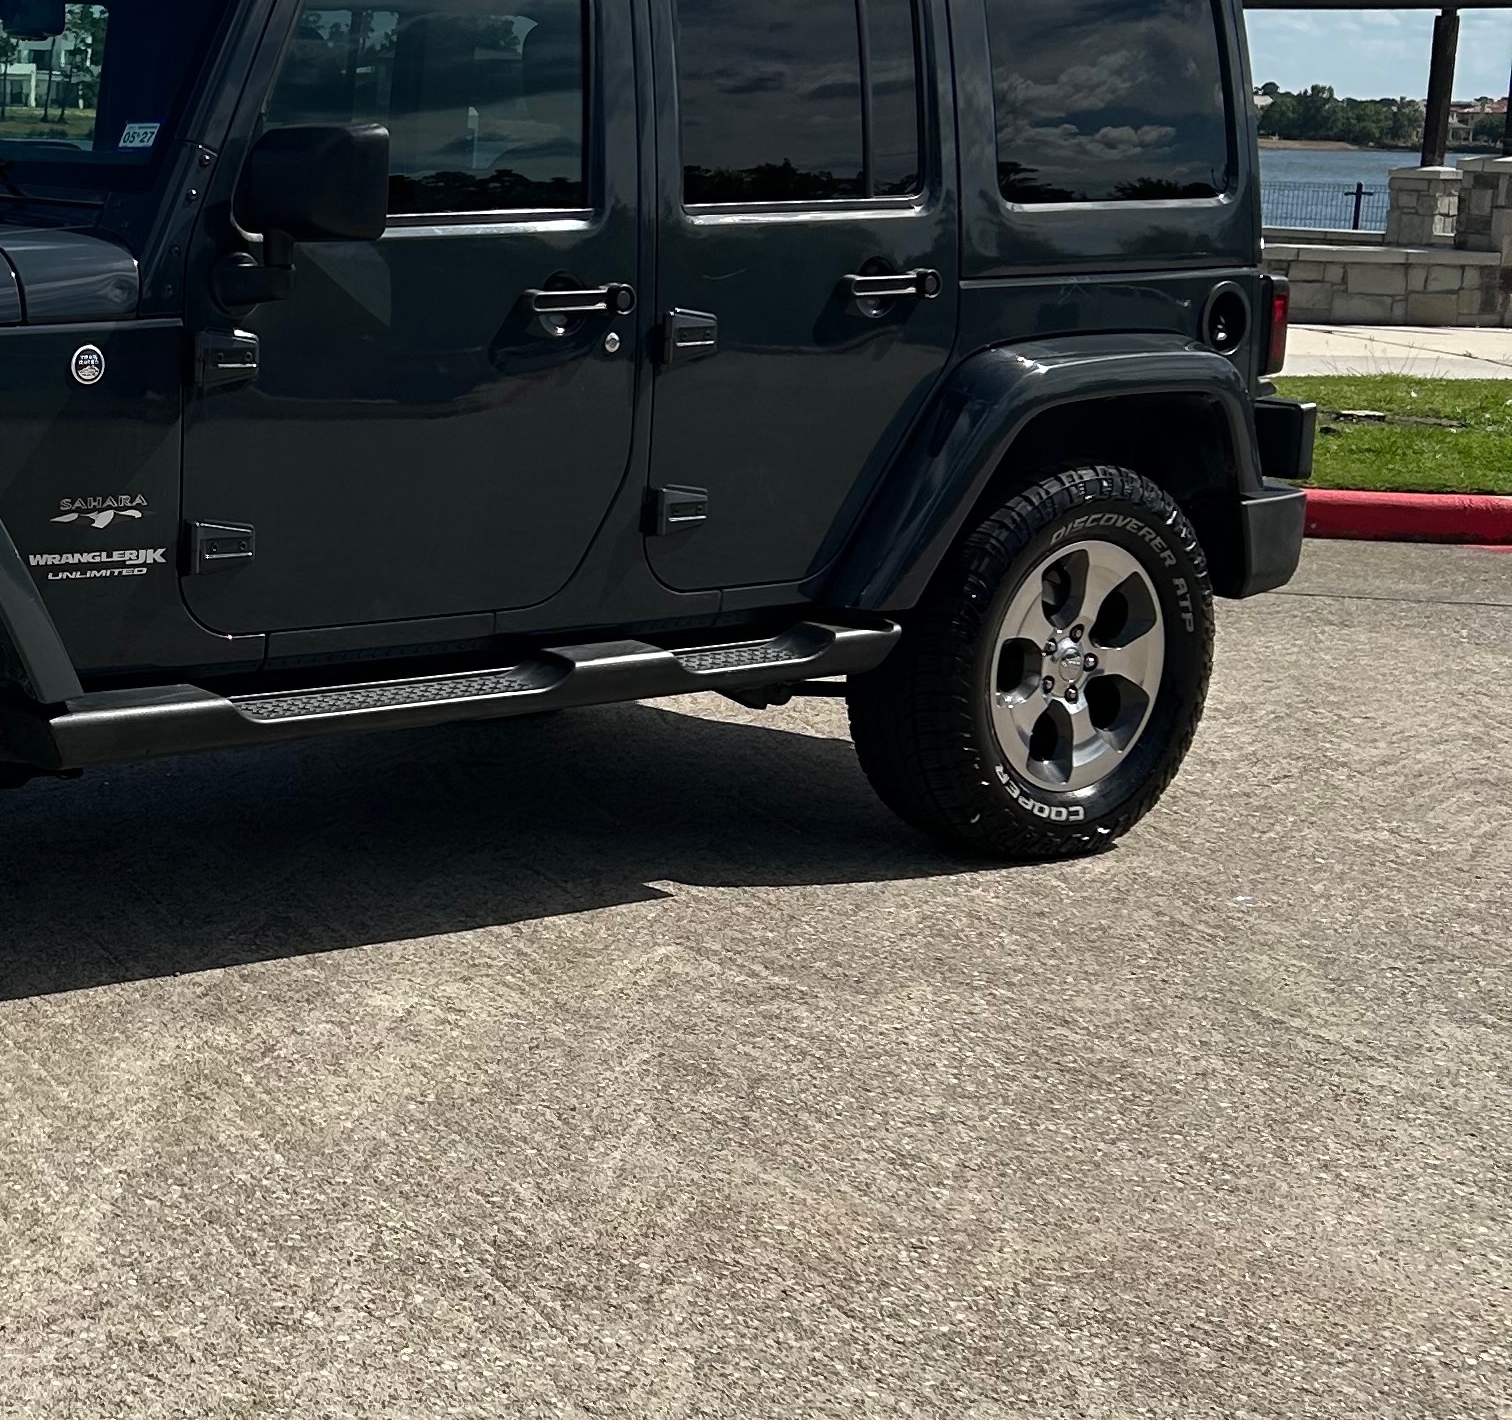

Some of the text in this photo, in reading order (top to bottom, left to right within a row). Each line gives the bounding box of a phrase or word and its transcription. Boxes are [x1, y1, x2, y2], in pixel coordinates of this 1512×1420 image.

[139, 131, 155, 144] 27
[60, 494, 148, 511] SAHARA
[48, 568, 148, 580] UNLIMITED
[1050, 513, 1194, 633] DISCOVERER ATP
[995, 764, 1085, 821] COOPER
